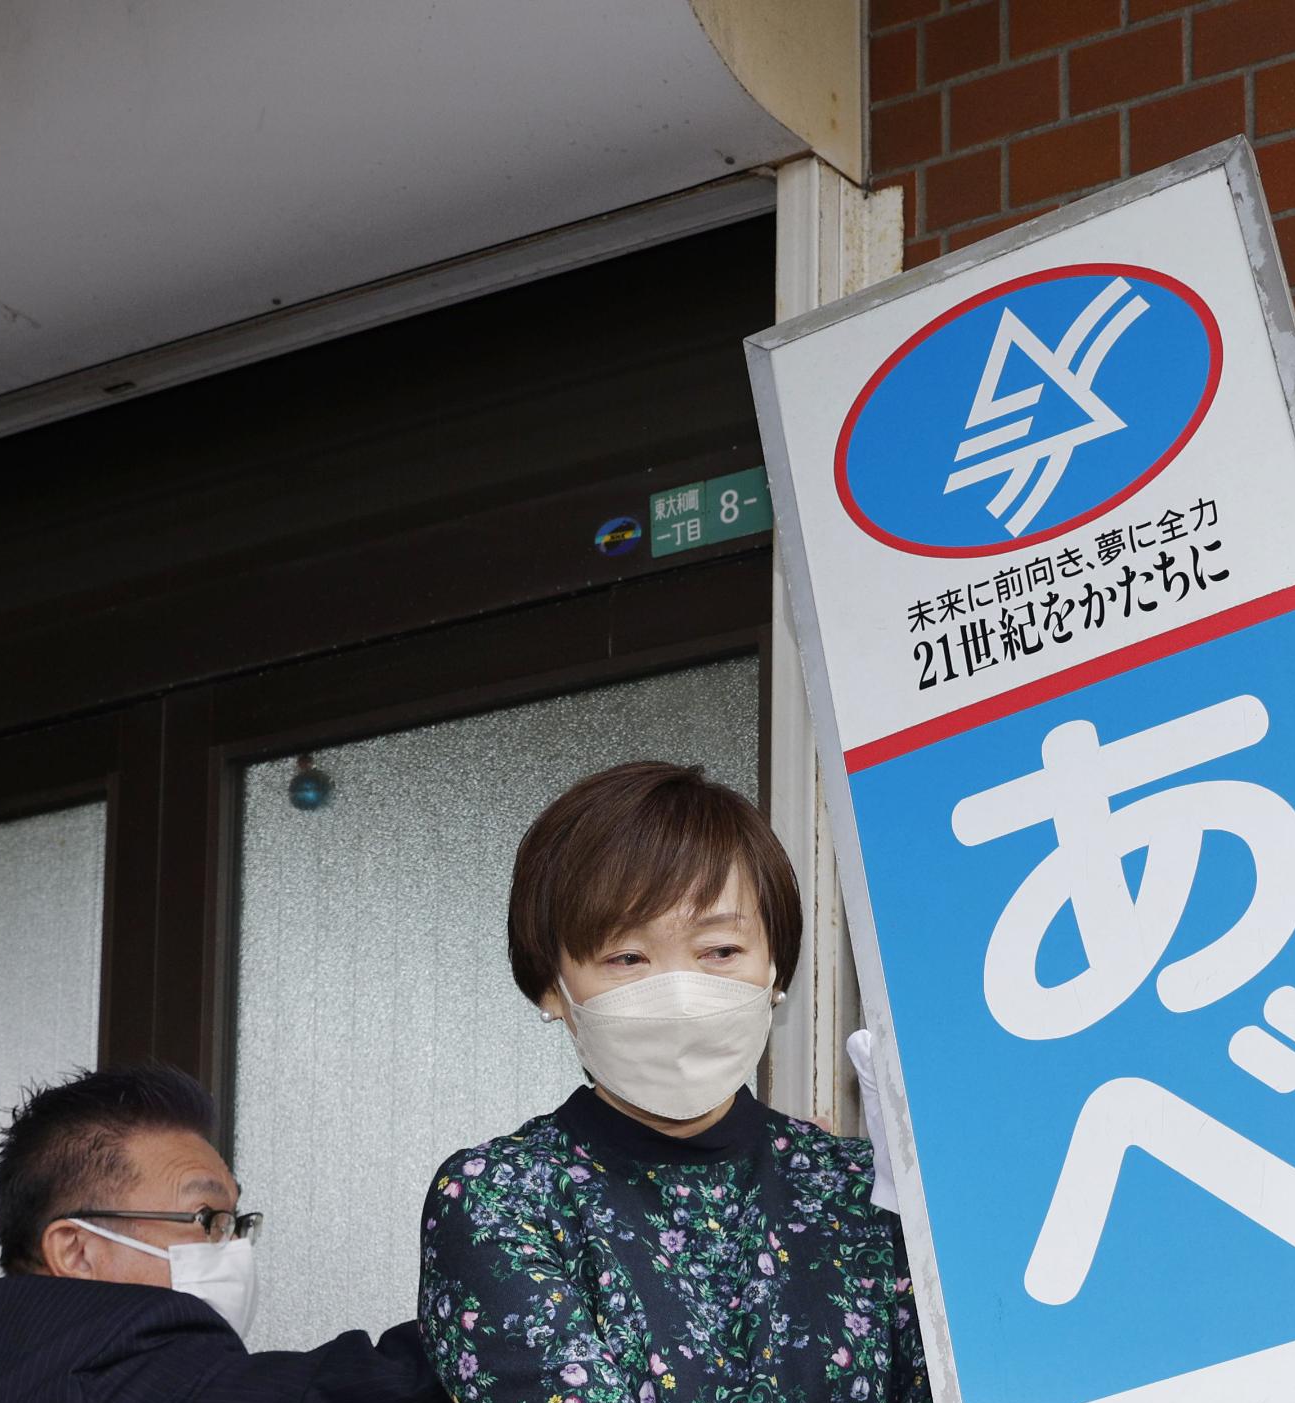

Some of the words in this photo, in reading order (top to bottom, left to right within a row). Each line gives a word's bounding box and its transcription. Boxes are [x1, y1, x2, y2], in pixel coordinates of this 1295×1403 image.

[654, 488, 700, 521] 東大和町
[656, 518, 702, 546] 一丁目
[907, 497, 1218, 633] 未来に前向き、夢に全力
[912, 540, 1230, 691] 21世紀をかたちに
